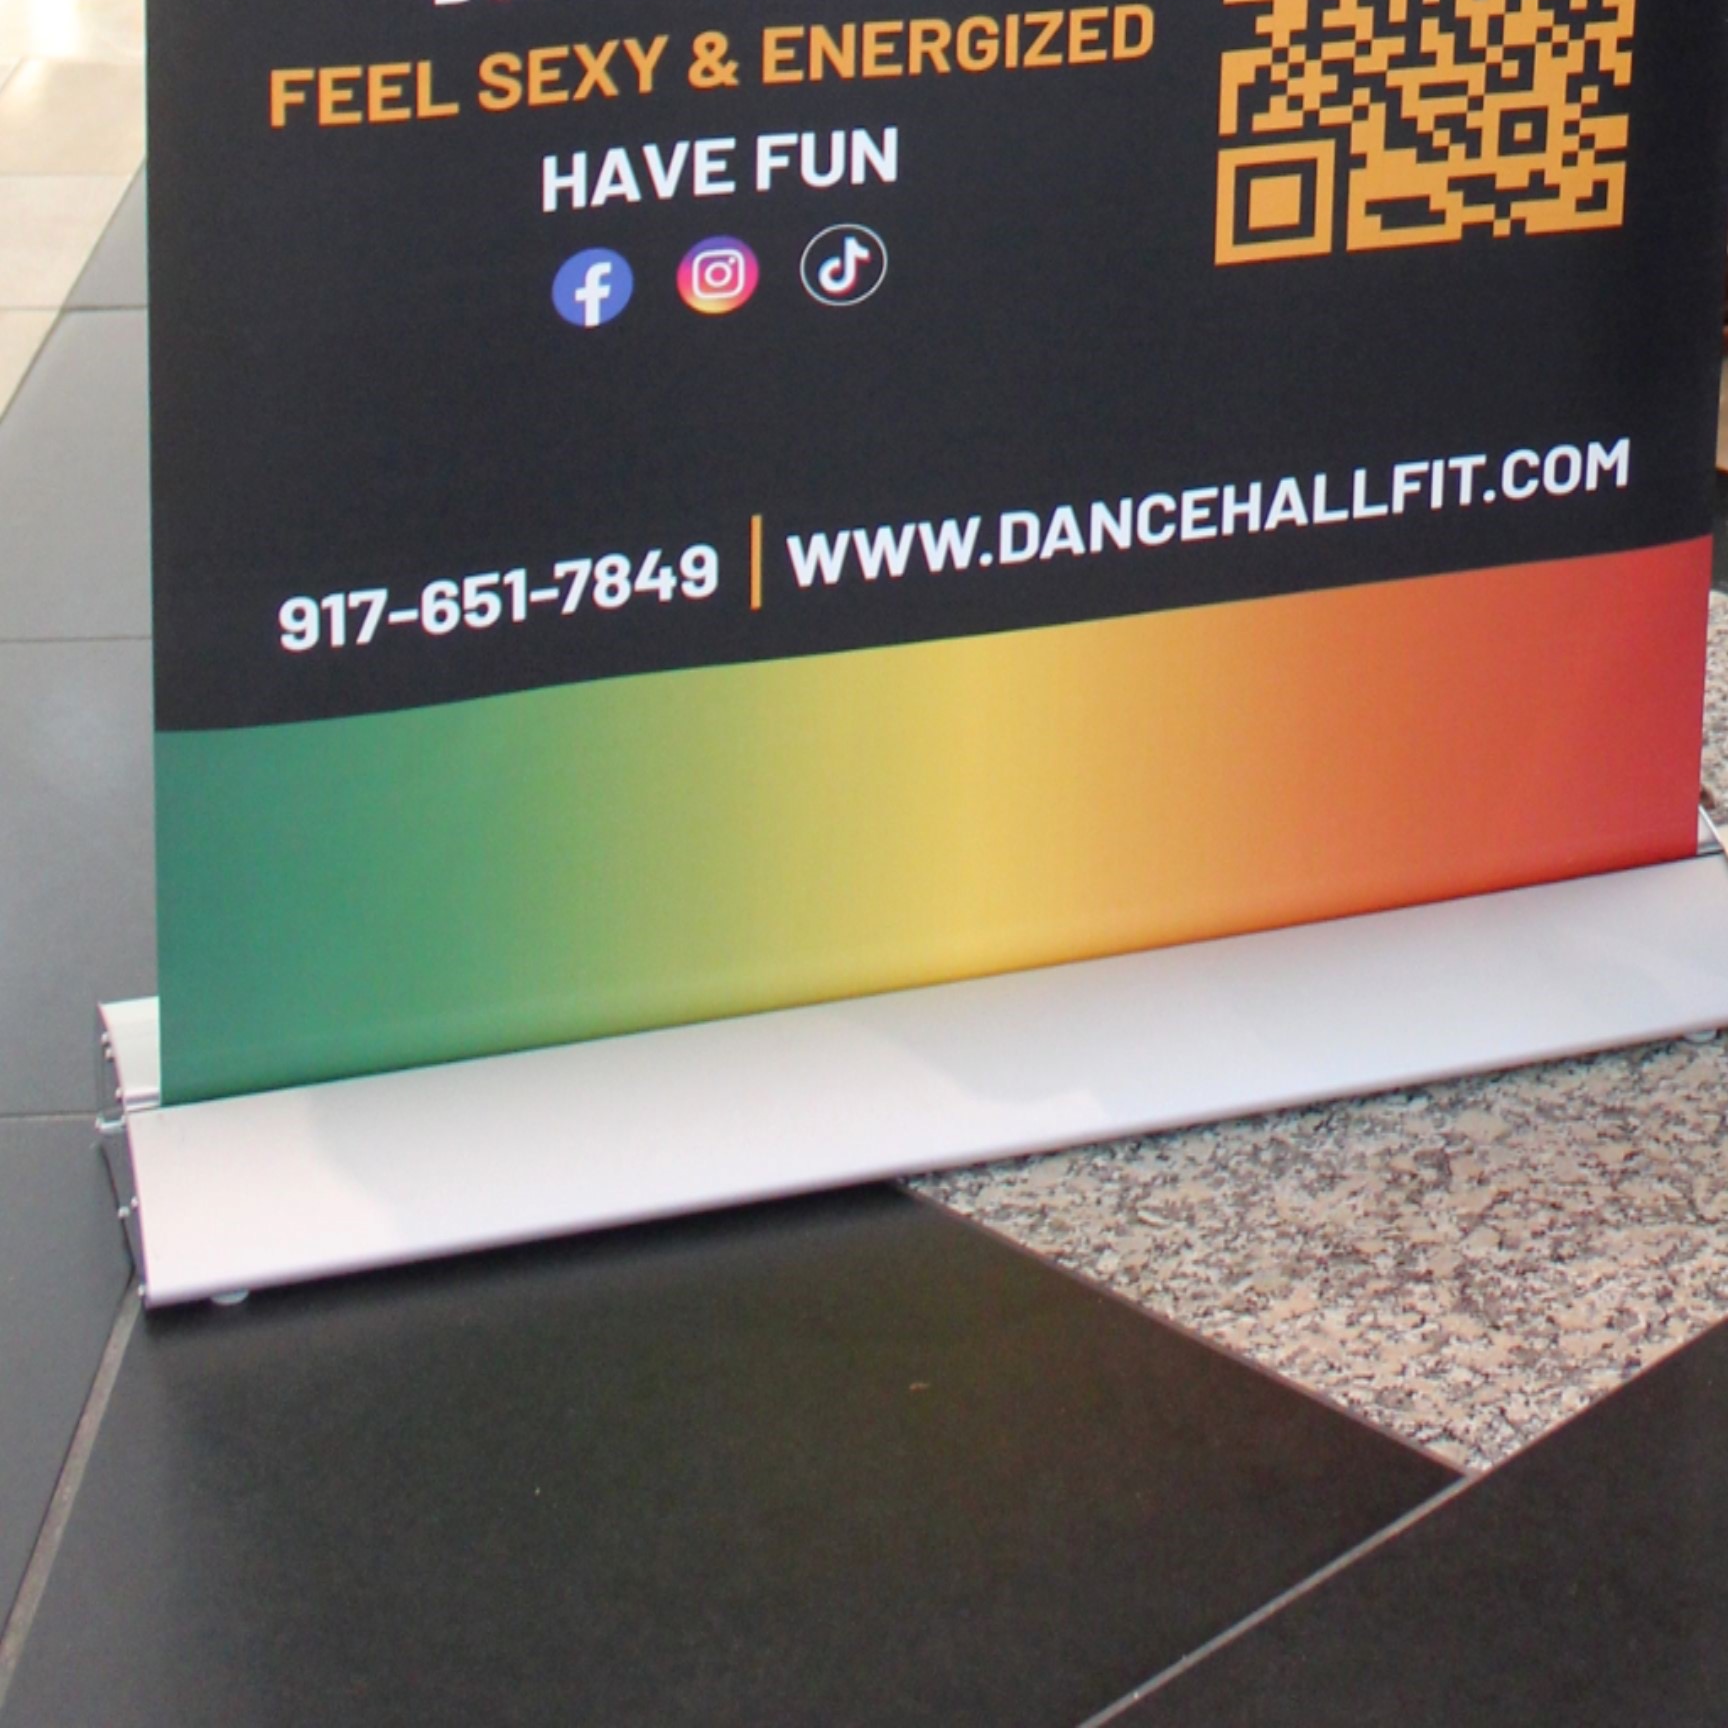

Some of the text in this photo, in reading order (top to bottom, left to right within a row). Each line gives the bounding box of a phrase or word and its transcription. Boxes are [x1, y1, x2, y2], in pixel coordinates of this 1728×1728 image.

[268, 1, 1158, 128] FEEL SEXY & ENERGIZED
[540, 126, 900, 212] HAVE FUN
[277, 437, 1633, 652] 917-651-7849 WWW.DANCEHALLFIT.COM
